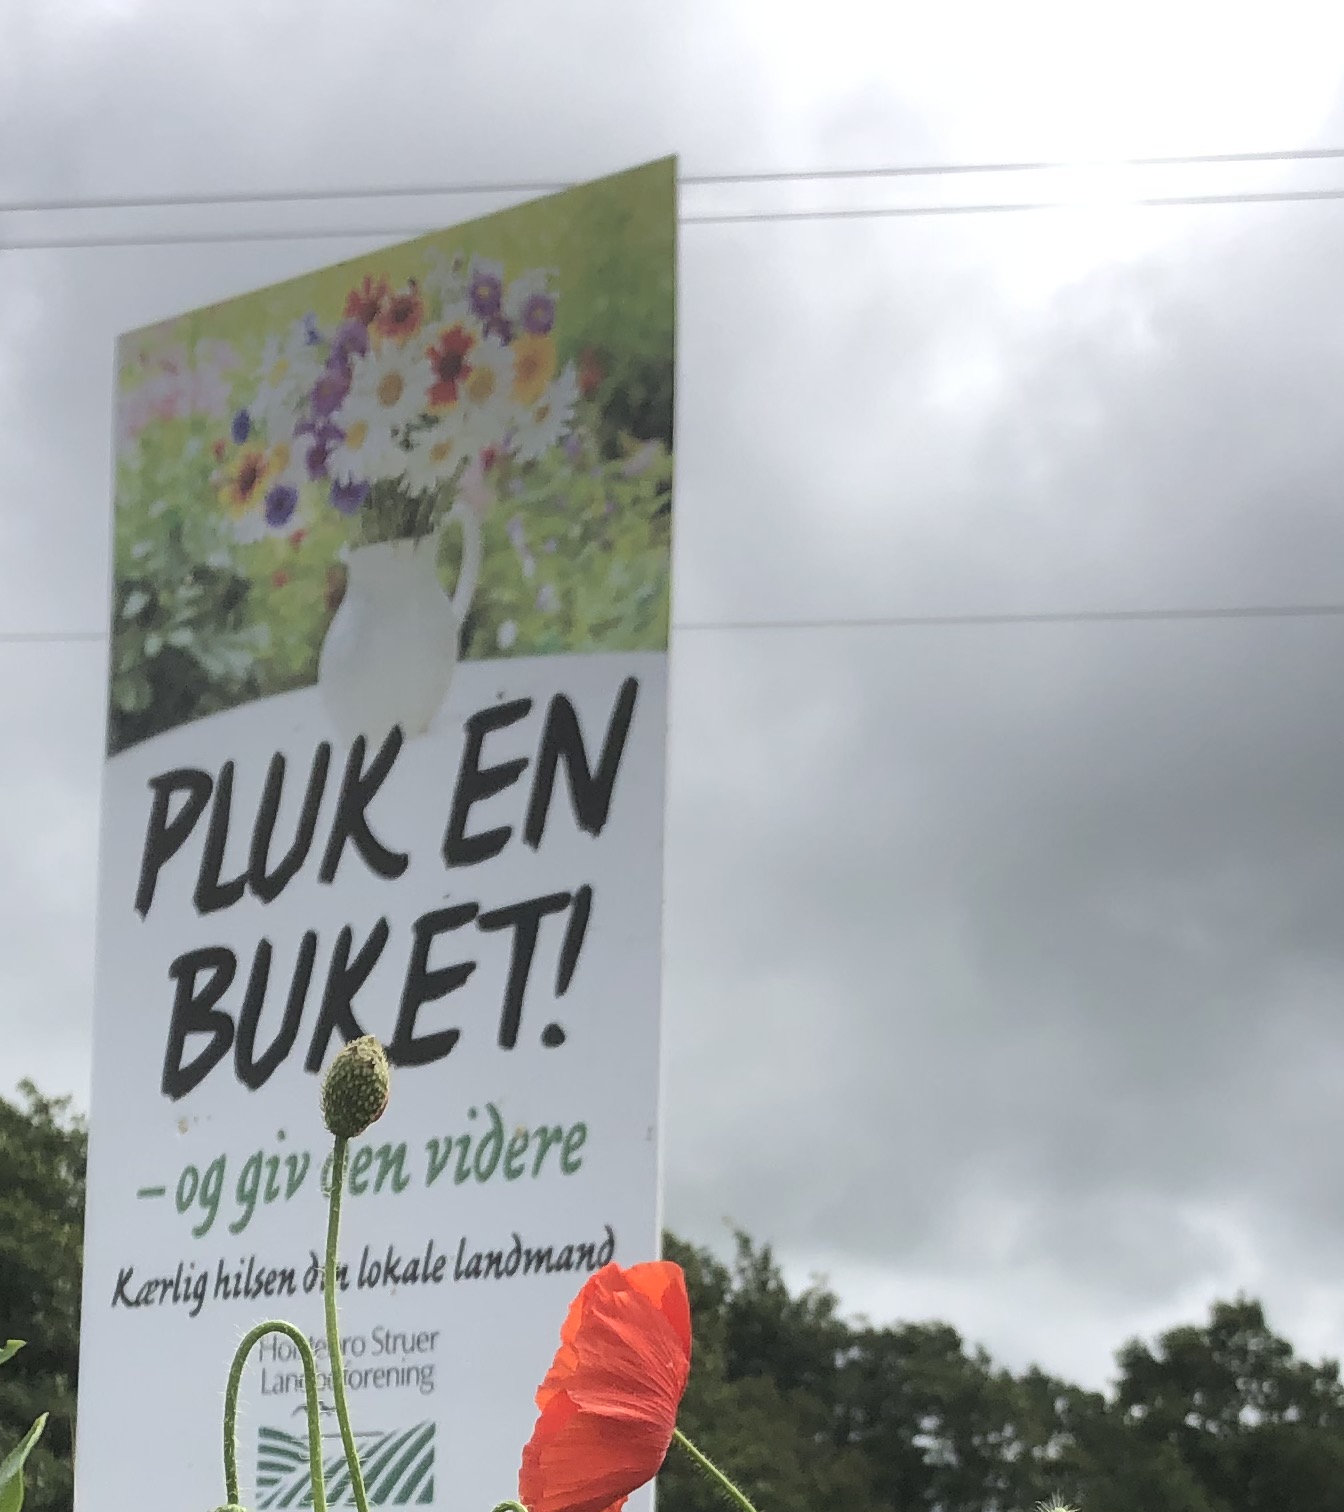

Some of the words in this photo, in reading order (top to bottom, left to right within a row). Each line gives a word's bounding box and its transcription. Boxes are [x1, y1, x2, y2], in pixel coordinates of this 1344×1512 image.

[134, 725, 409, 921] PLUK
[440, 675, 639, 869] EN
[161, 884, 593, 1101] BUKET!
[228, 1128, 311, 1236] giv
[424, 1102, 588, 1188] videre
[111, 1257, 209, 1318] Kærlig
[213, 1253, 297, 1300] hilsen
[302, 1249, 350, 1294] dn
[357, 1238, 447, 1290] lokale
[453, 1223, 616, 1281] landmand
[371, 1325, 441, 1356] Struer
